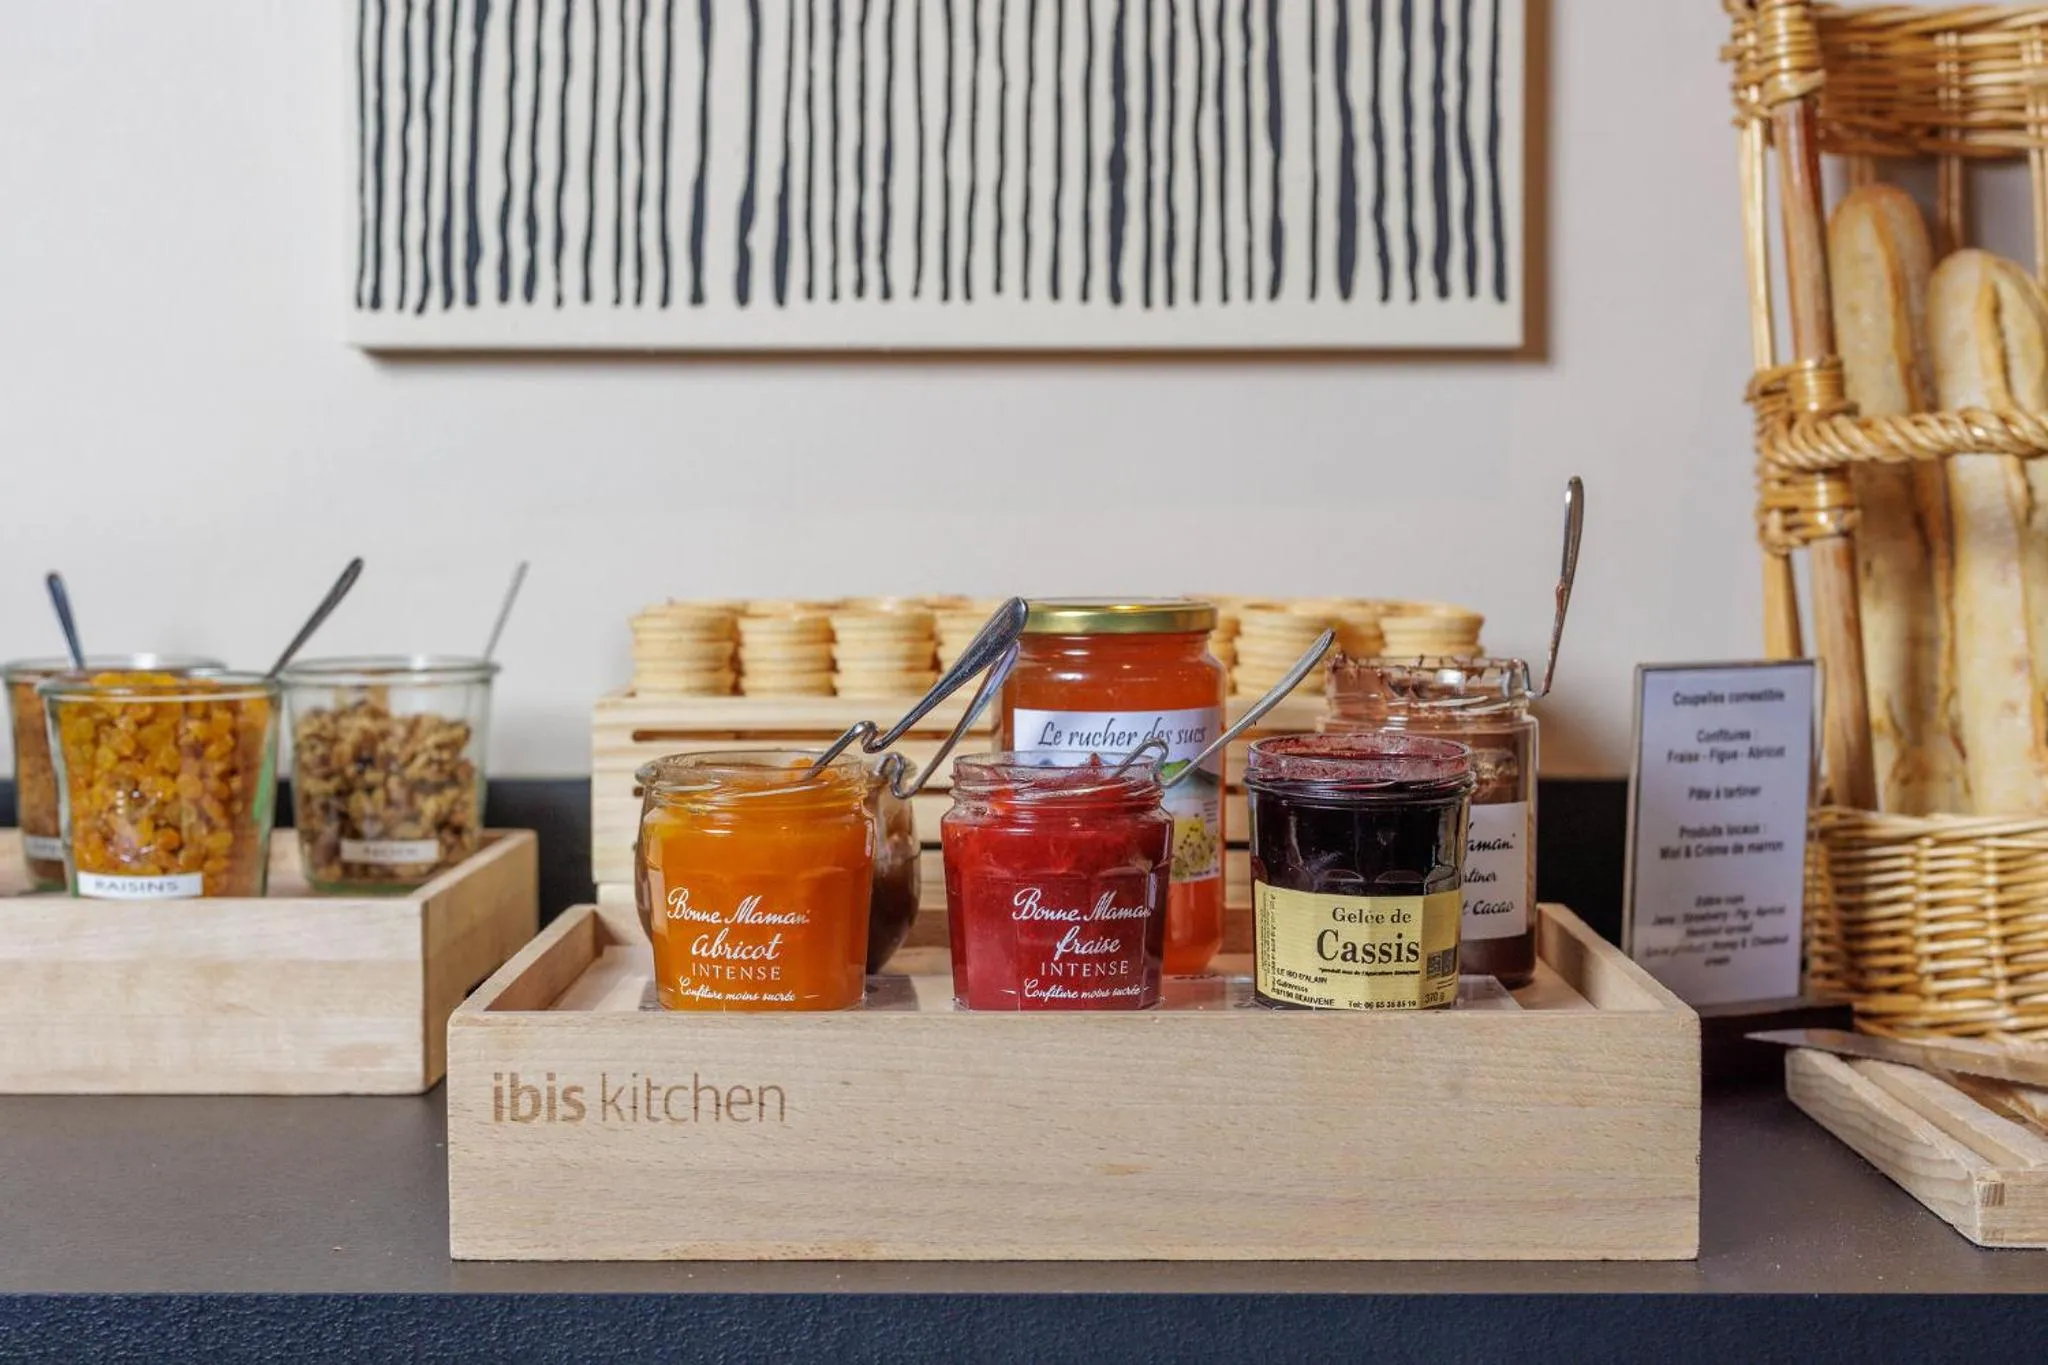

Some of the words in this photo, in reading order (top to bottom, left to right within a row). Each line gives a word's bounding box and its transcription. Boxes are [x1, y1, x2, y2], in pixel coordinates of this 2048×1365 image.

[1038, 721, 1063, 746] Le
[1068, 717, 1138, 747] rucher
[94, 880, 180, 894] RAISINS
[667, 886, 723, 925] Bonne
[724, 894, 811, 926] Maman
[1012, 886, 1082, 923] Bonne
[1083, 889, 1152, 923] Maman
[1331, 906, 1386, 925] Gelée
[1390, 908, 1412, 924] de
[1472, 900, 1515, 916] Cacao
[1316, 928, 1421, 965] Cassis
[691, 962, 782, 982] INTENSE
[1041, 960, 1129, 978] INTENSE
[679, 975, 723, 1002] Confiture
[725, 991, 760, 1002] moins
[1024, 977, 1079, 1003] Confiture
[1080, 988, 1111, 1000] moins
[493, 1071, 587, 1124] ibis
[601, 1071, 786, 1124] kitchen
